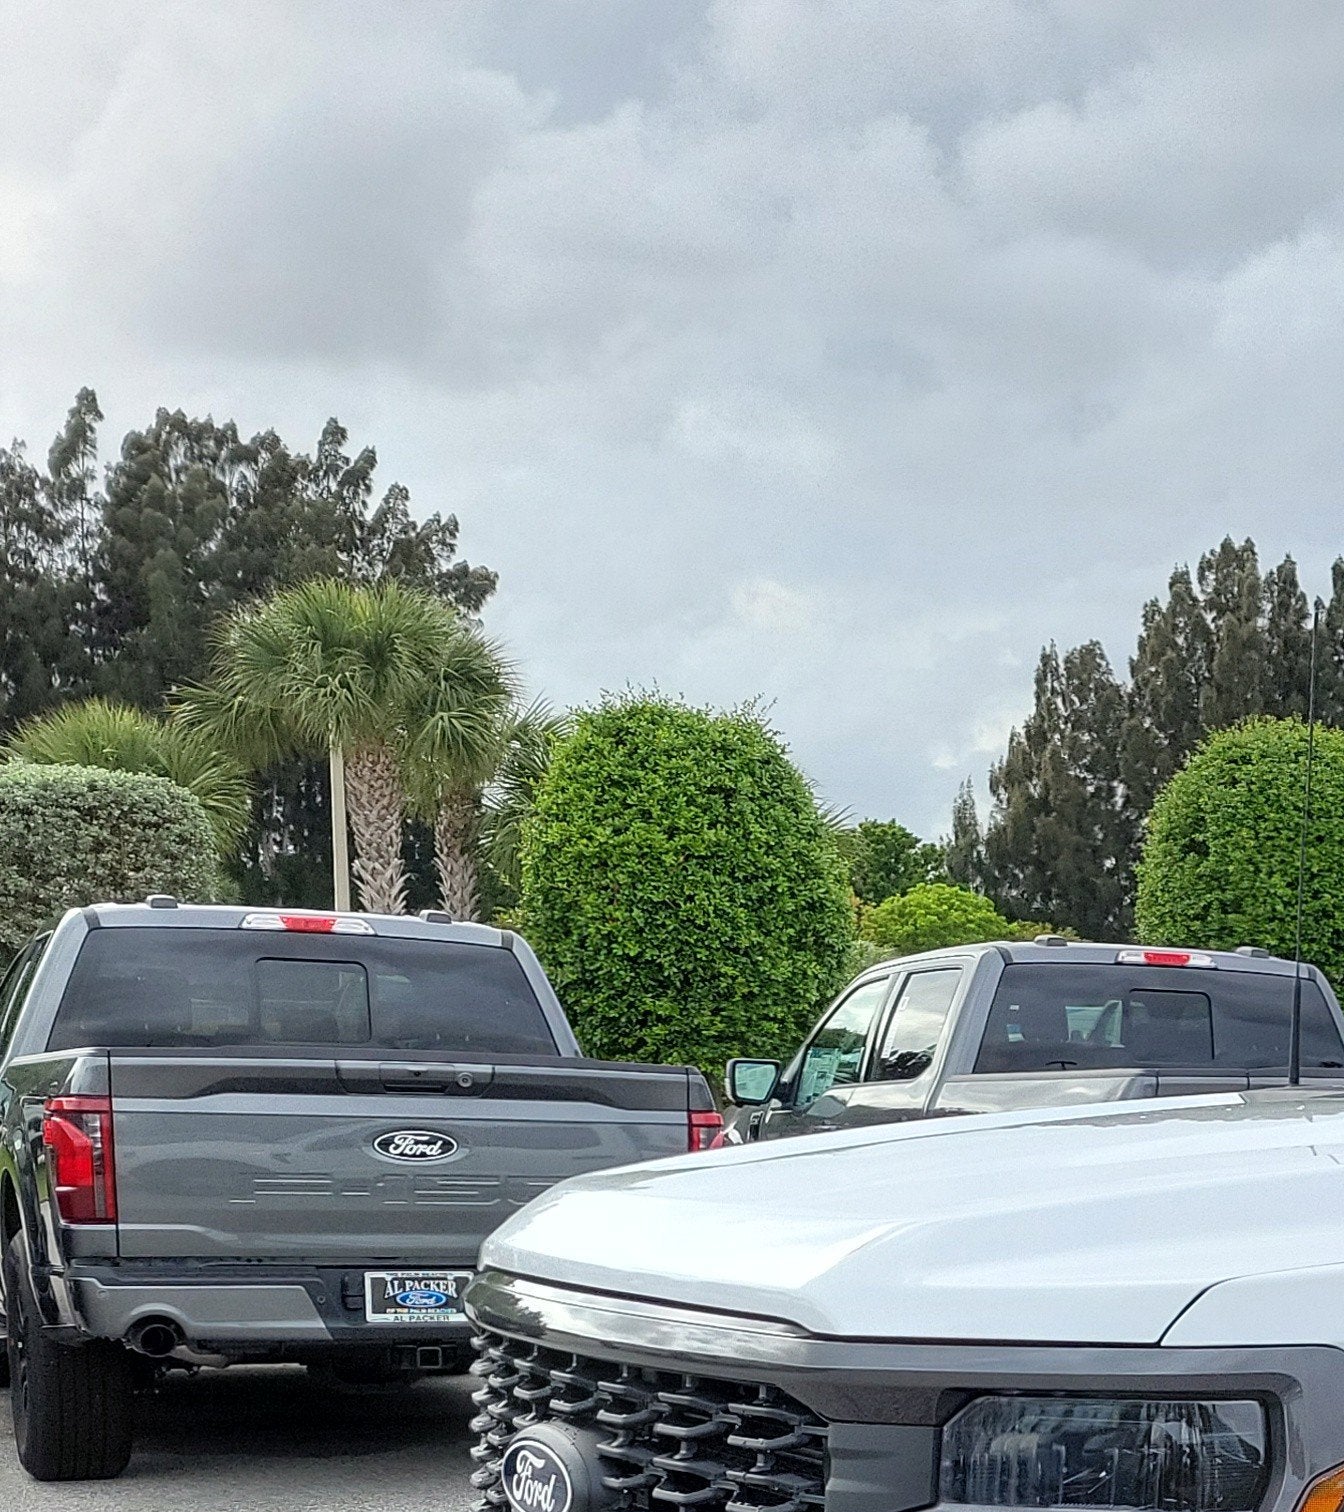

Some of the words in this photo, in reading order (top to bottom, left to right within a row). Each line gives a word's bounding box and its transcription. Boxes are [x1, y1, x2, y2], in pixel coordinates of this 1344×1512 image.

[388, 1134, 443, 1156] Ford
[384, 1280, 403, 1299] AL
[404, 1280, 458, 1299] PACKER
[405, 1293, 437, 1305] Ford
[512, 1449, 557, 1512] Ford
